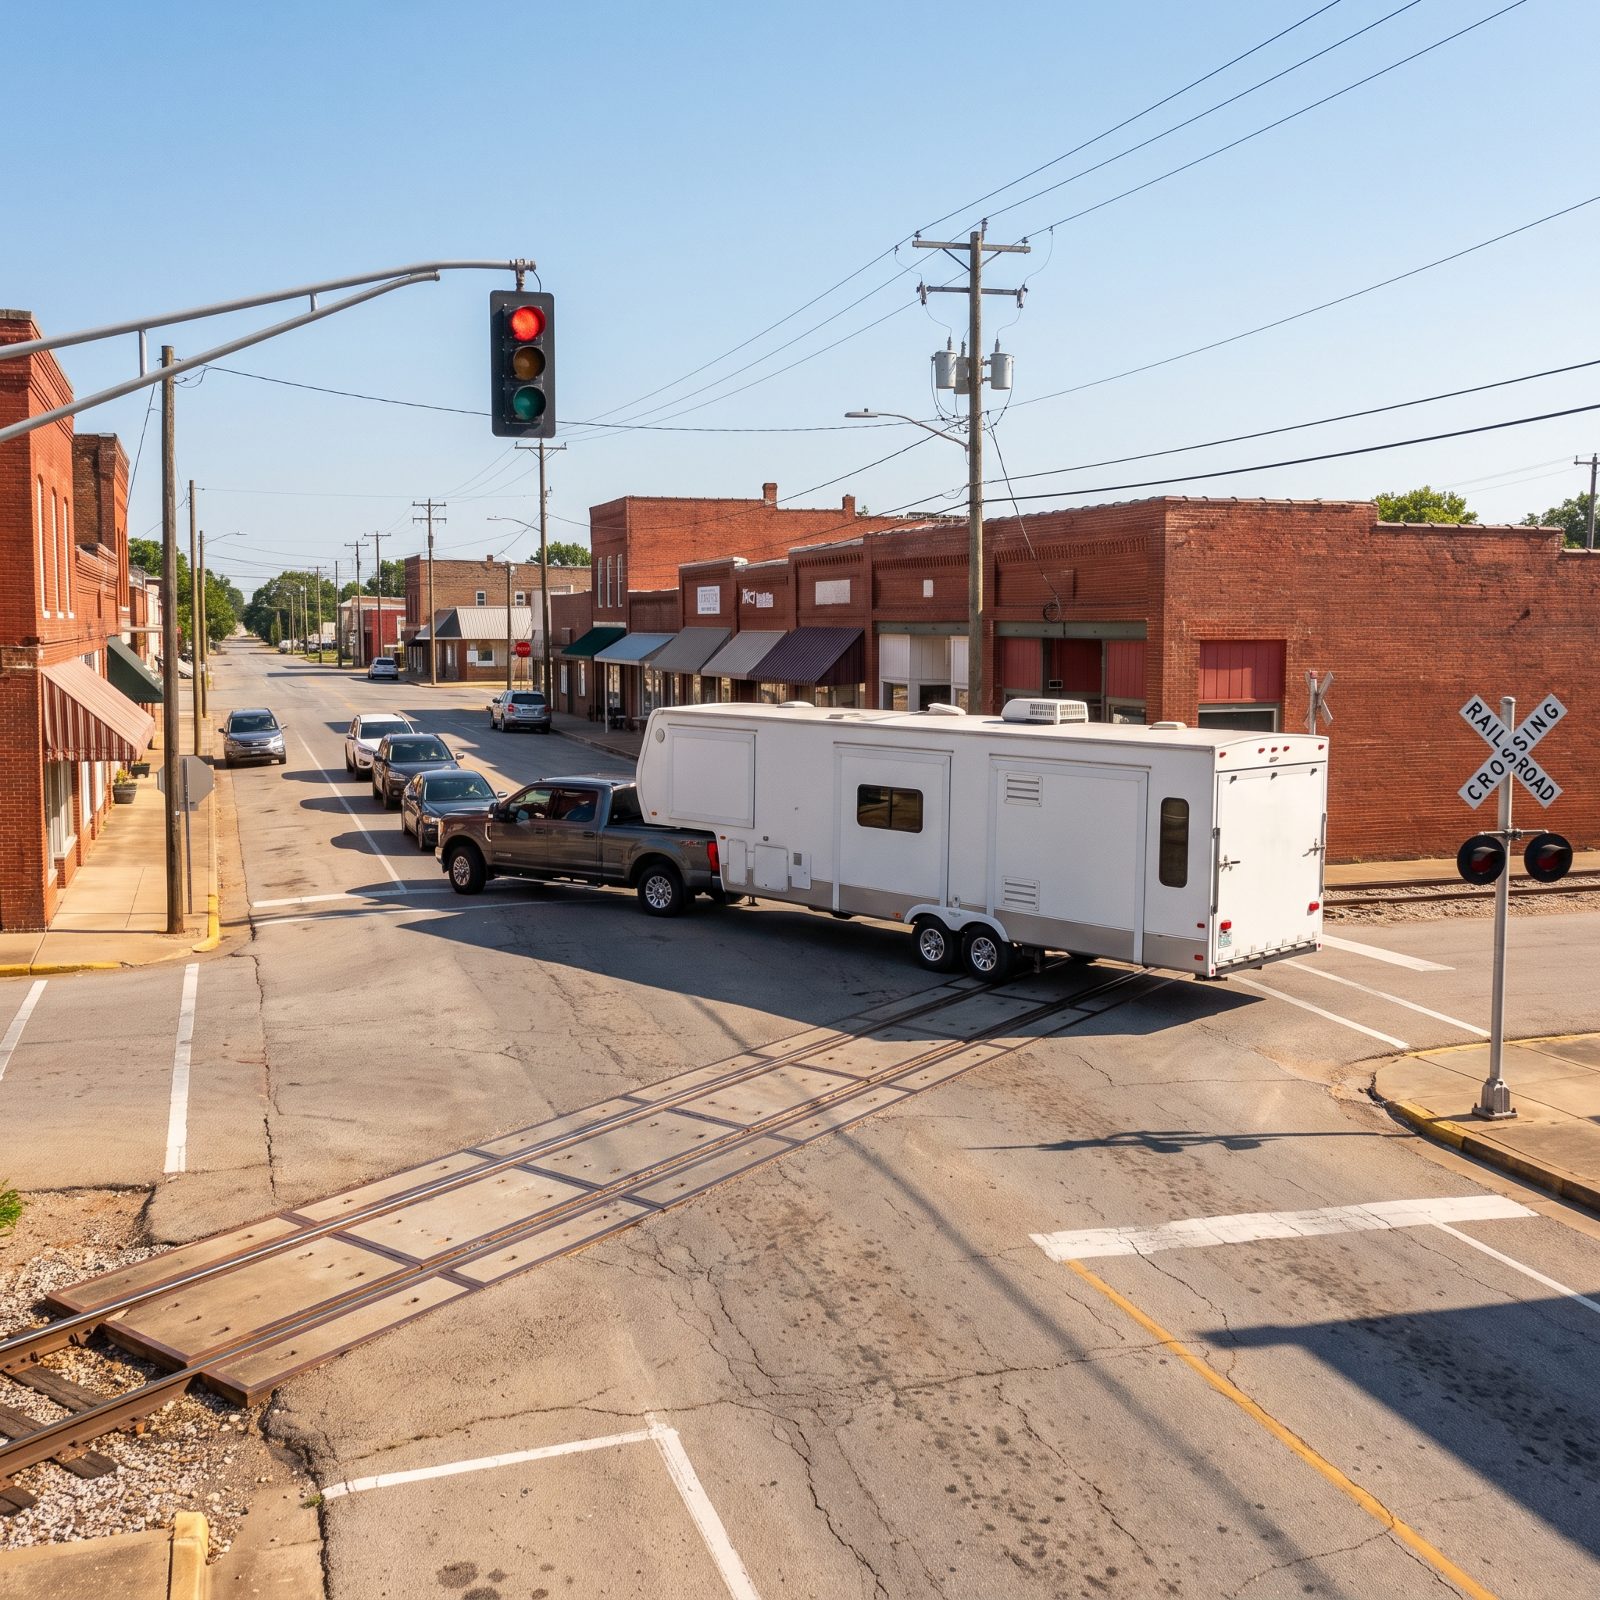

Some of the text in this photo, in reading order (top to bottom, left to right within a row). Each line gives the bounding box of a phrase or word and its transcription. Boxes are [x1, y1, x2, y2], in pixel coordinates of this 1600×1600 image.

[1465, 701, 1555, 801] RAIL ROAD
[1467, 703, 1559, 801] CROSSING
